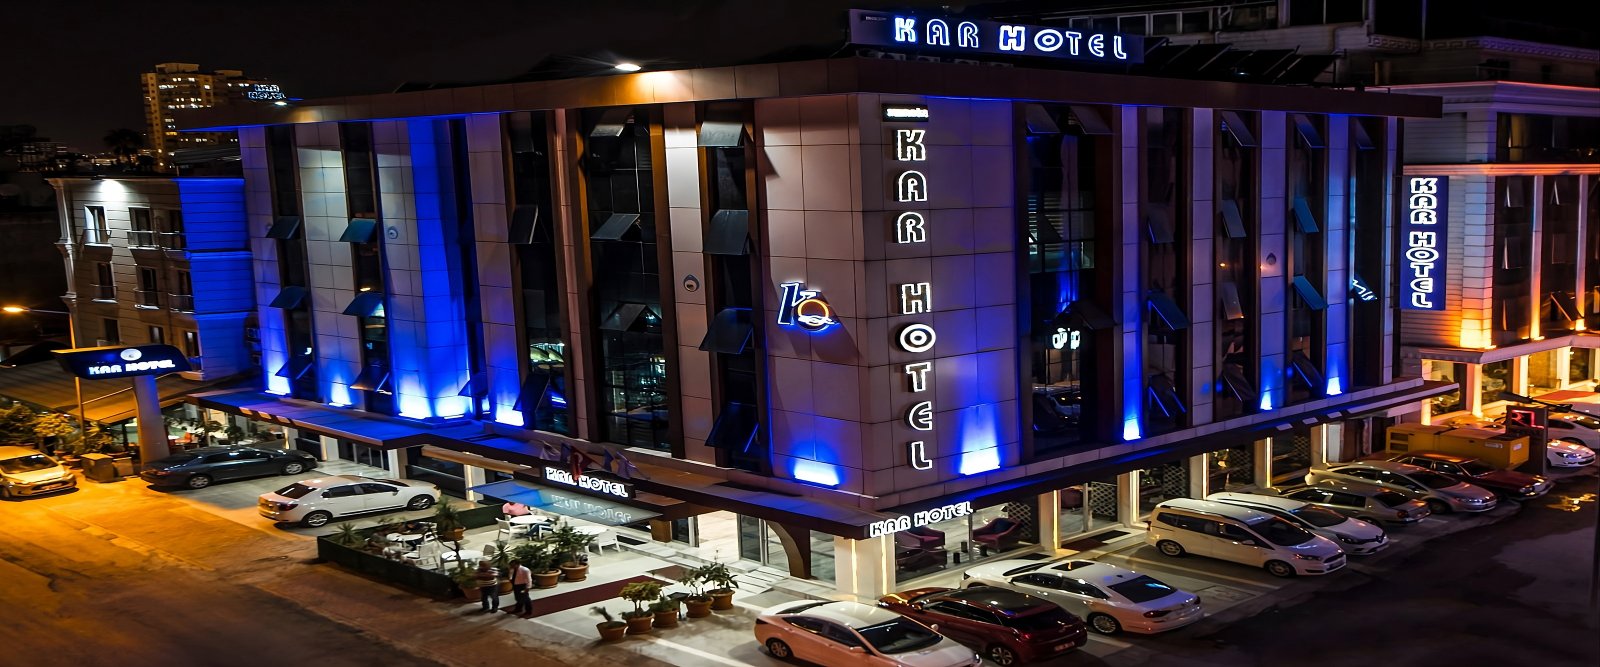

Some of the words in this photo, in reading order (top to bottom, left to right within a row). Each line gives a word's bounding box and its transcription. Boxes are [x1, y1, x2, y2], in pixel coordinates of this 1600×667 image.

[894, 17, 979, 48] KAR
[999, 25, 1127, 59] HOTEL
[897, 129, 927, 243] KAR
[1409, 177, 1438, 225] KAR
[1405, 231, 1439, 308] HOTEL
[89, 364, 122, 375] KAR
[125, 360, 176, 372] HOTEL
[899, 282, 936, 471] HOTEL
[578, 475, 629, 498] HOTEL
[869, 516, 911, 538] KAR
[914, 501, 974, 527] HOTEL
